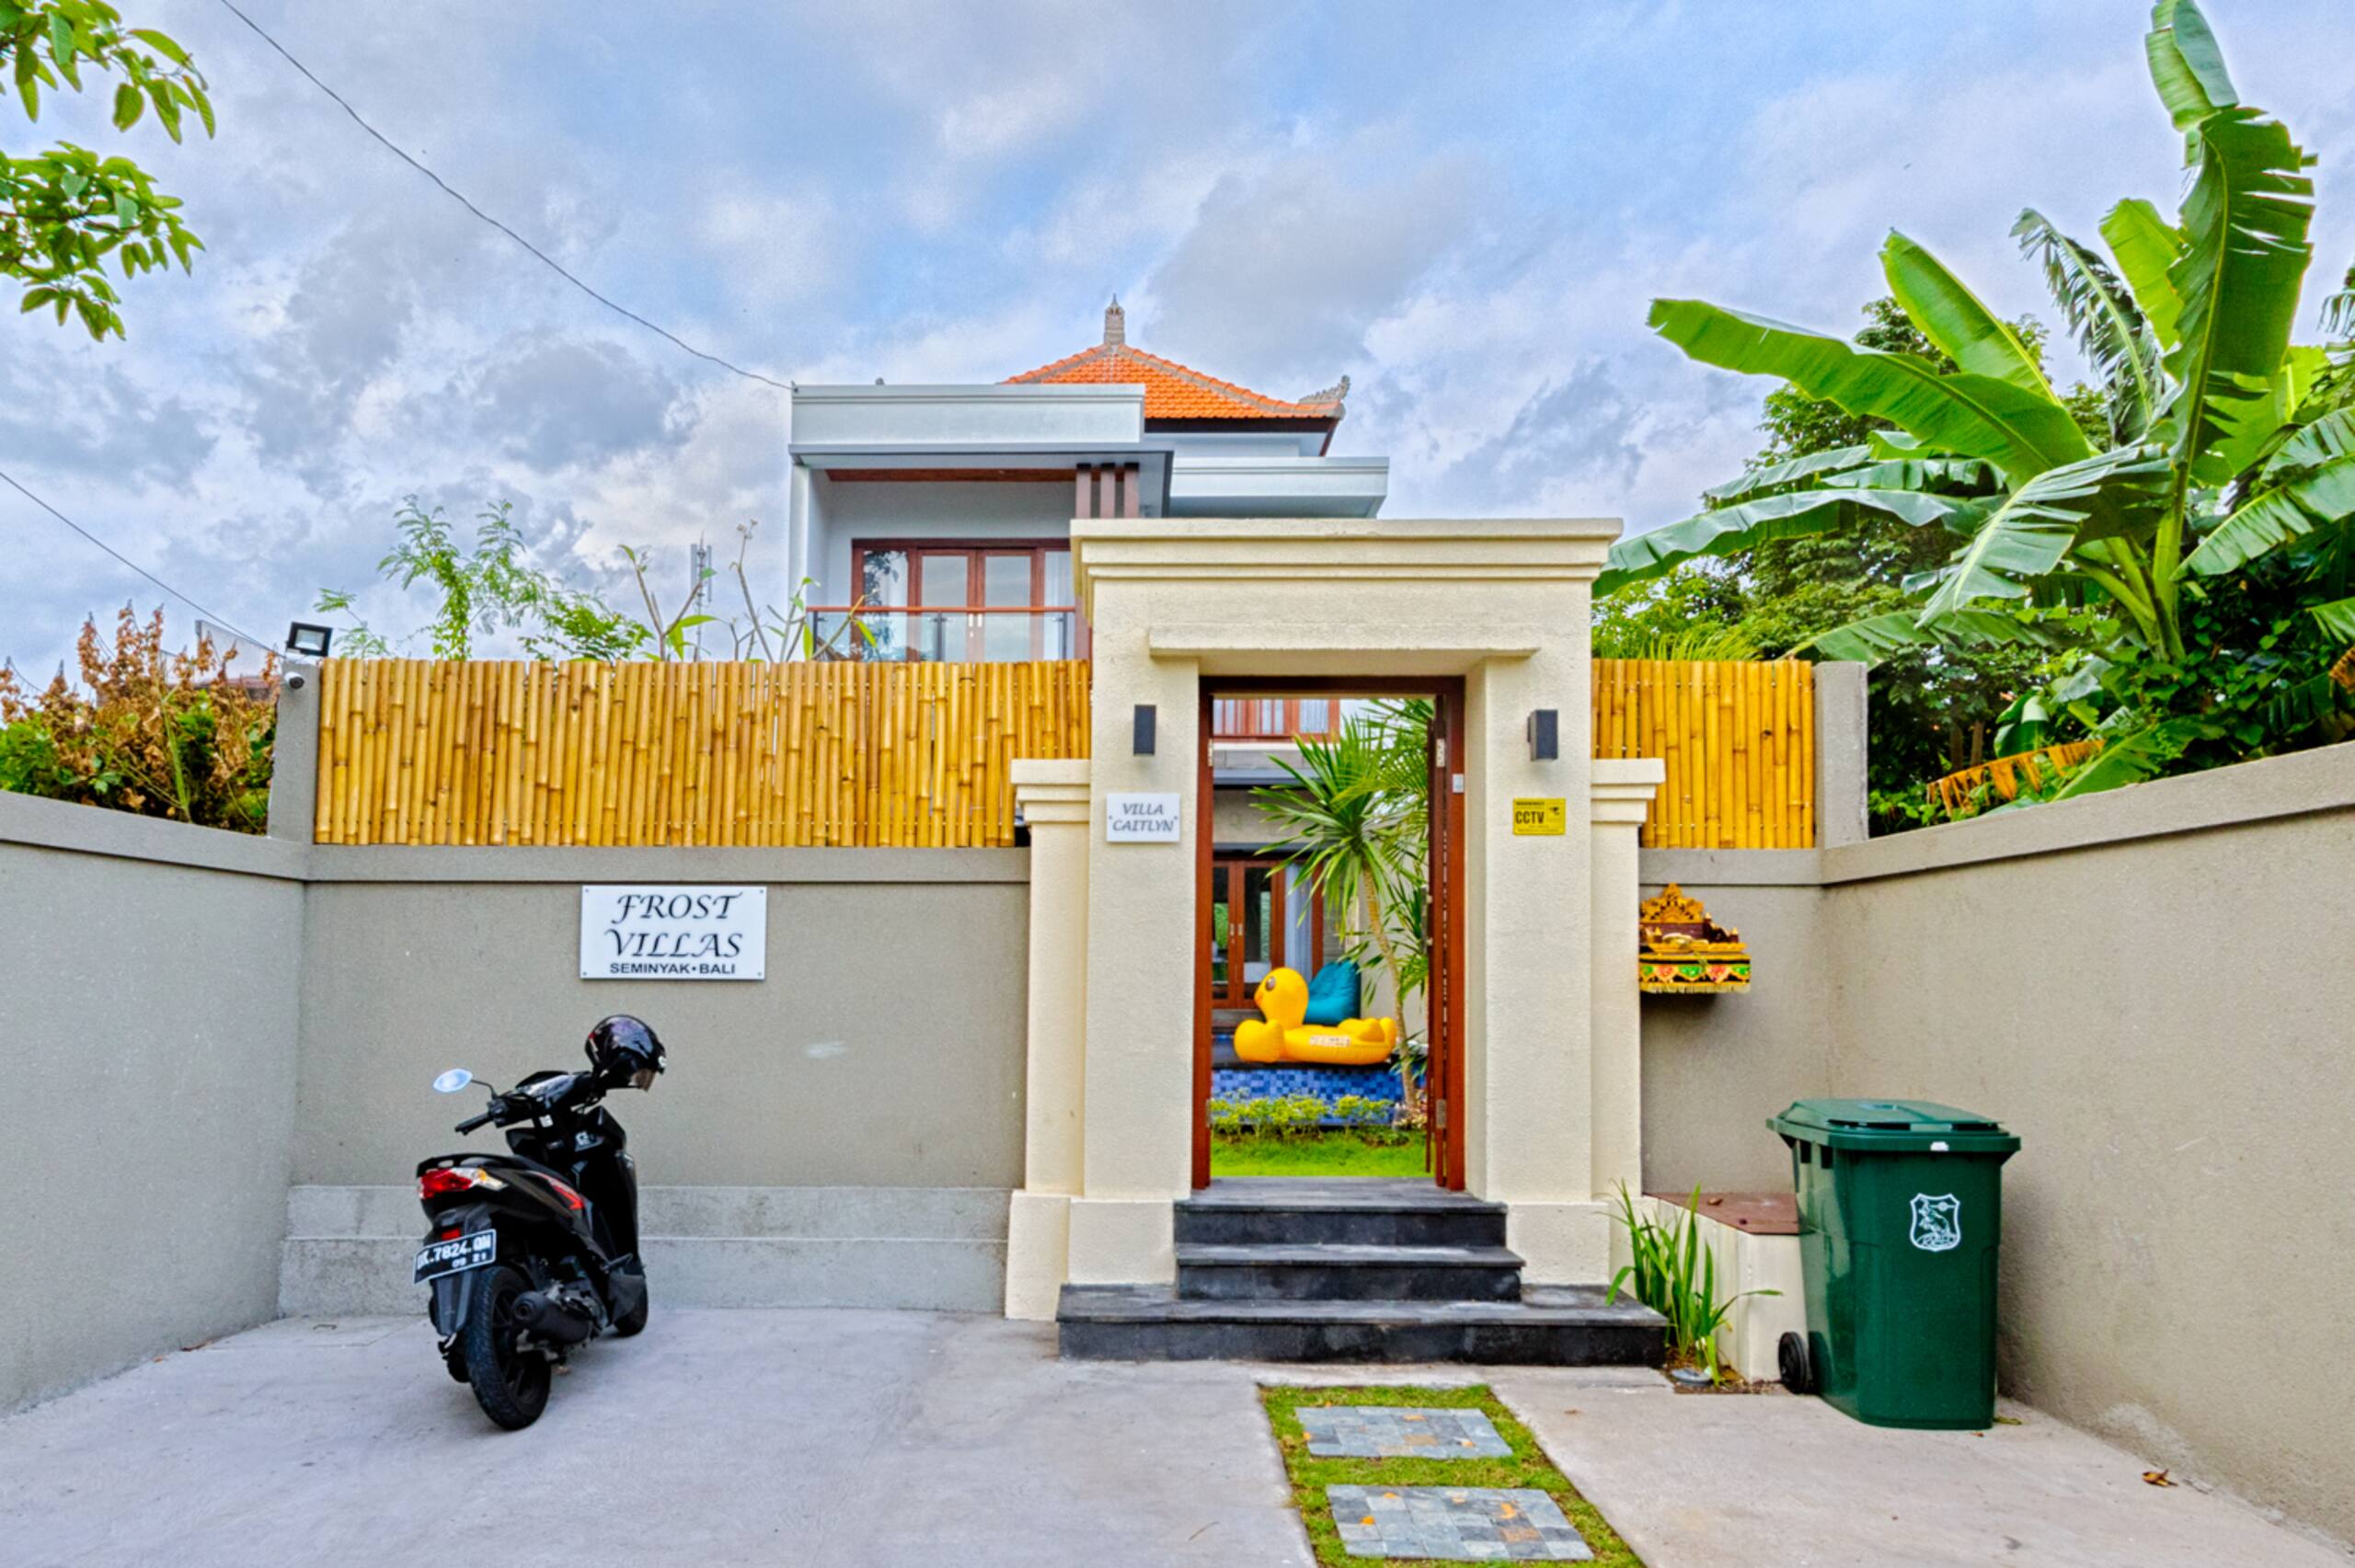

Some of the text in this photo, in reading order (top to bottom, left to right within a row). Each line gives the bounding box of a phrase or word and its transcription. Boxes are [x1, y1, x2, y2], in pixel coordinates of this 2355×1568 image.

[1122, 802, 1164, 815] VILLA
[1515, 810, 1545, 824] CCTV
[1112, 819, 1174, 832] CAITLYN
[611, 891, 743, 924] FROST
[603, 928, 743, 958] VILLAS
